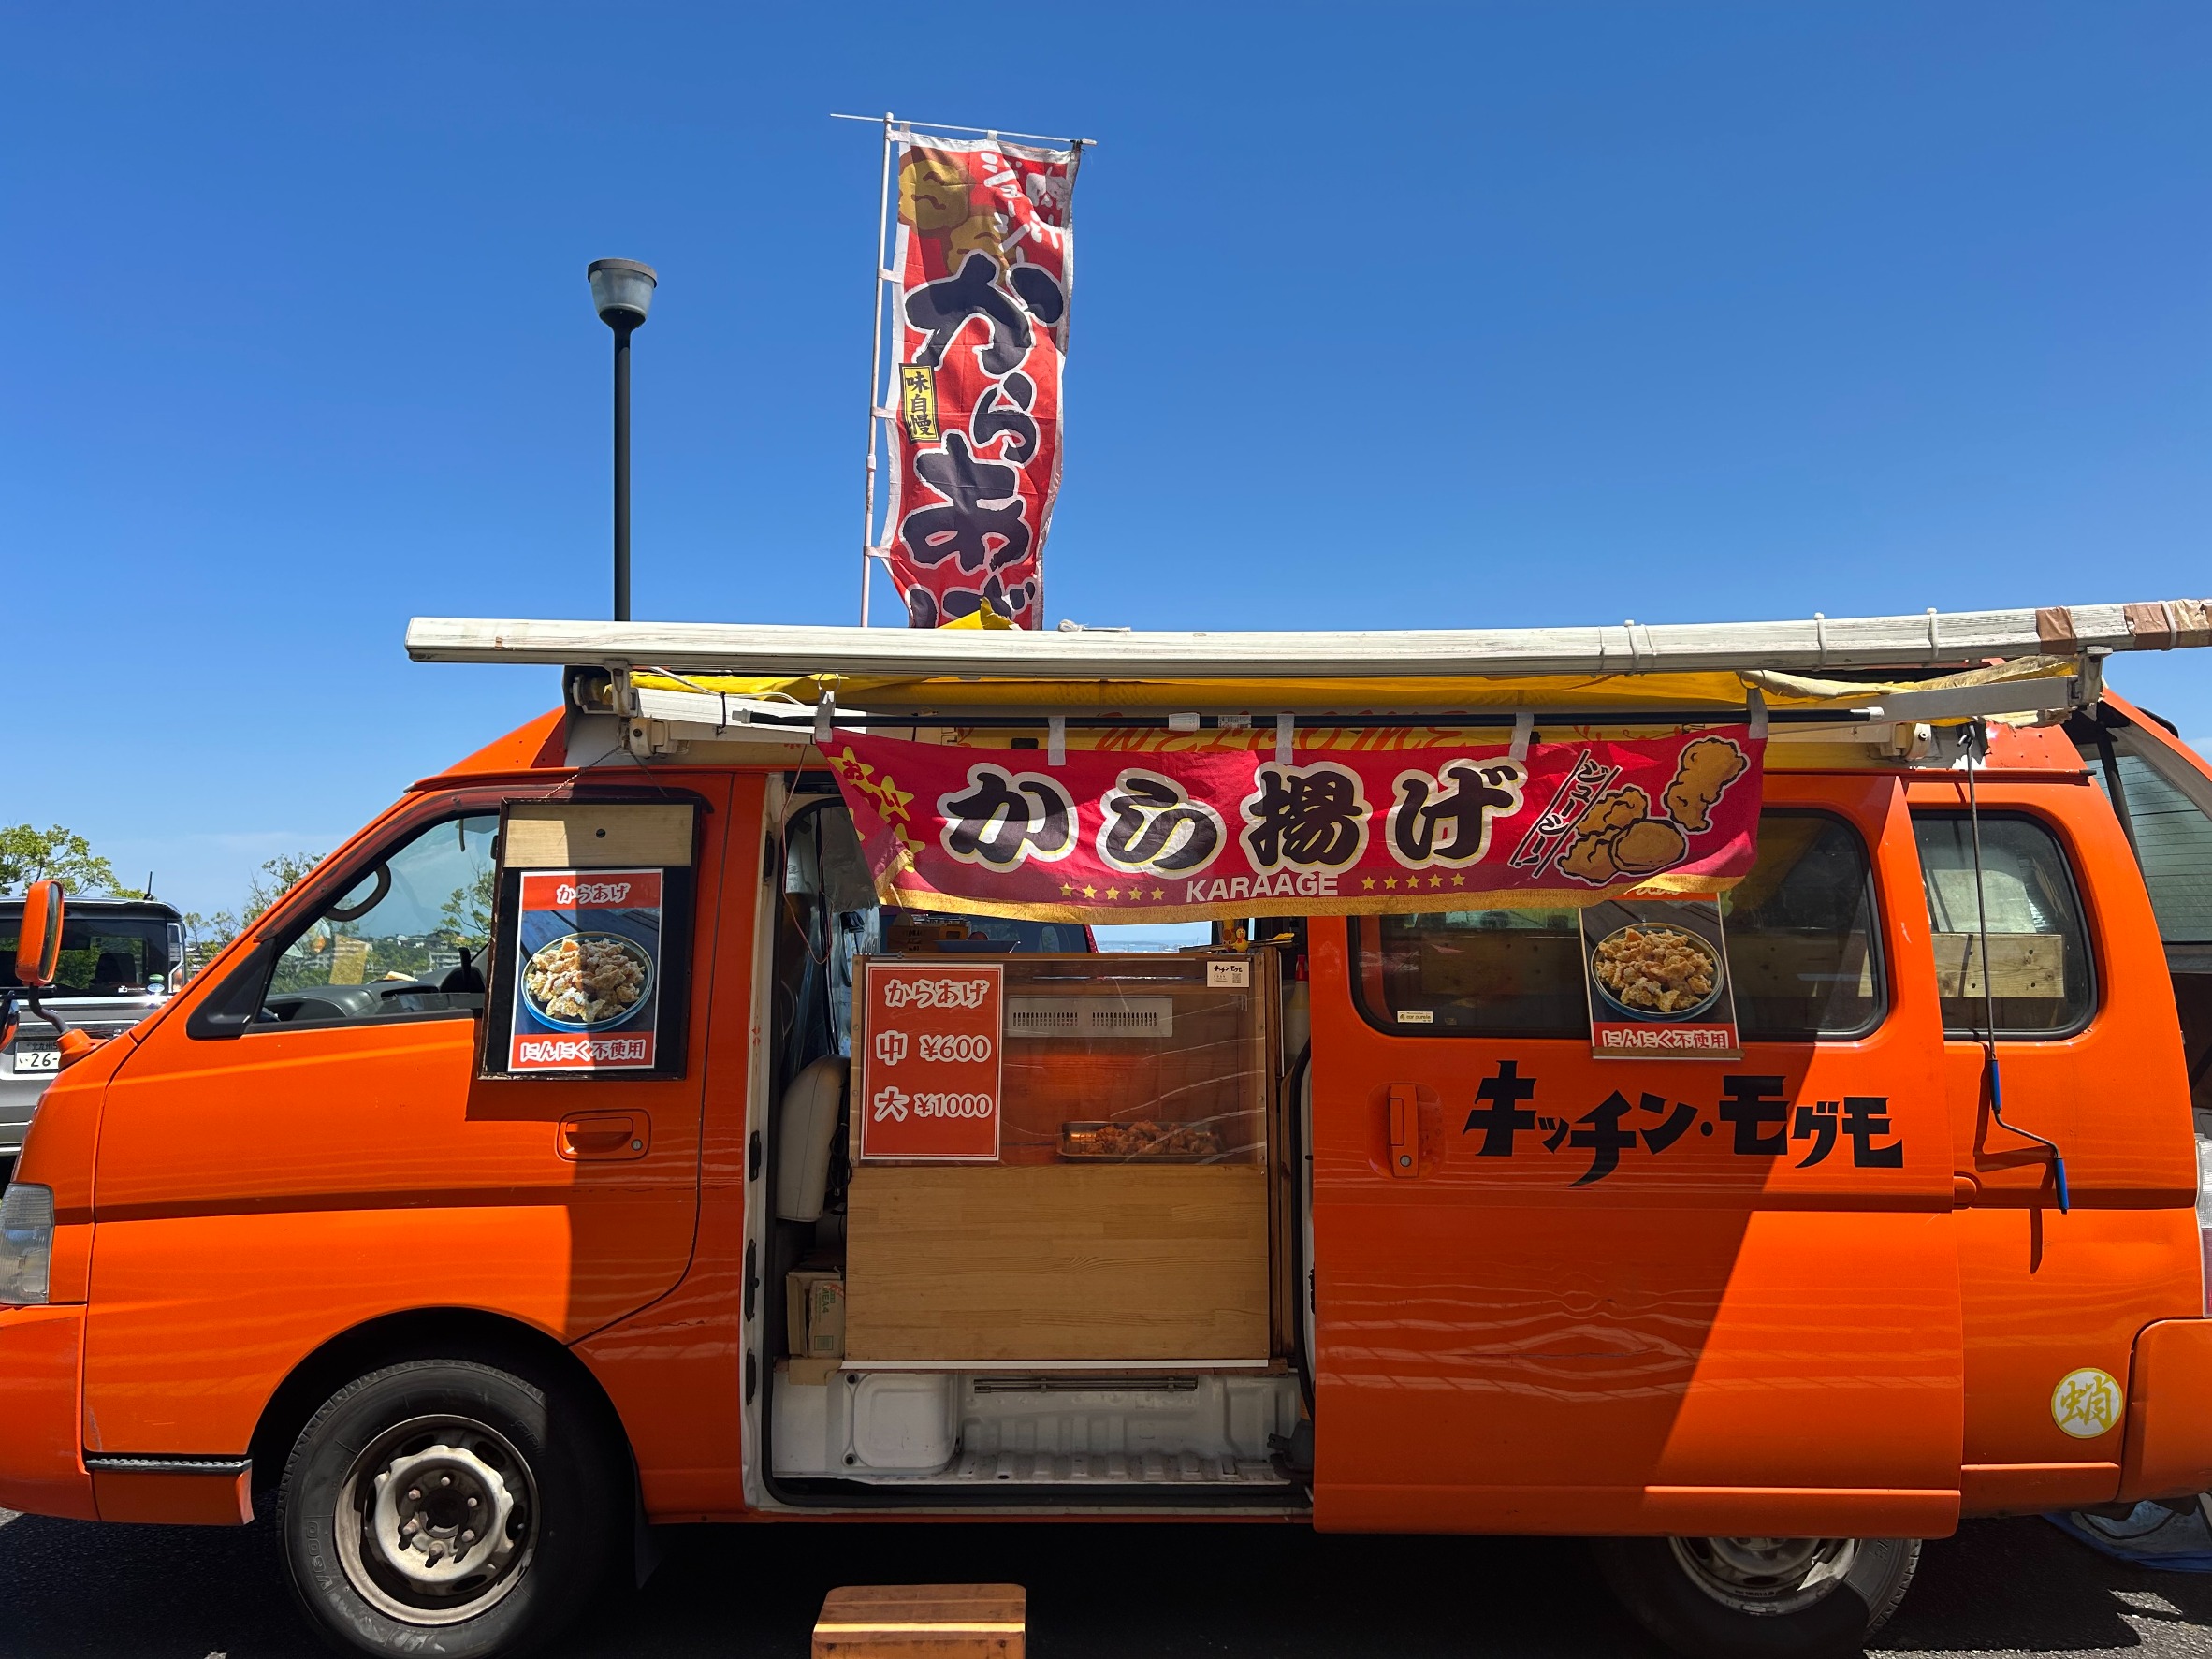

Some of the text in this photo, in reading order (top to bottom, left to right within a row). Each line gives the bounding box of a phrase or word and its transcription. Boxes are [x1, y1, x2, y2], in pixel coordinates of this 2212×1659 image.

[905, 371, 935, 435] 味自慢
[938, 759, 1529, 880] から揚げ
[556, 882, 631, 905] からあげ
[1186, 873, 1339, 903] KARAAGE
[884, 979, 990, 1009] からあげ
[519, 1037, 647, 1062] にんにく不使用
[876, 1030, 992, 1066] 中 ¥600
[1601, 1028, 1729, 1049] にんにく不使用
[874, 1086, 993, 1122] 大 ¥1000
